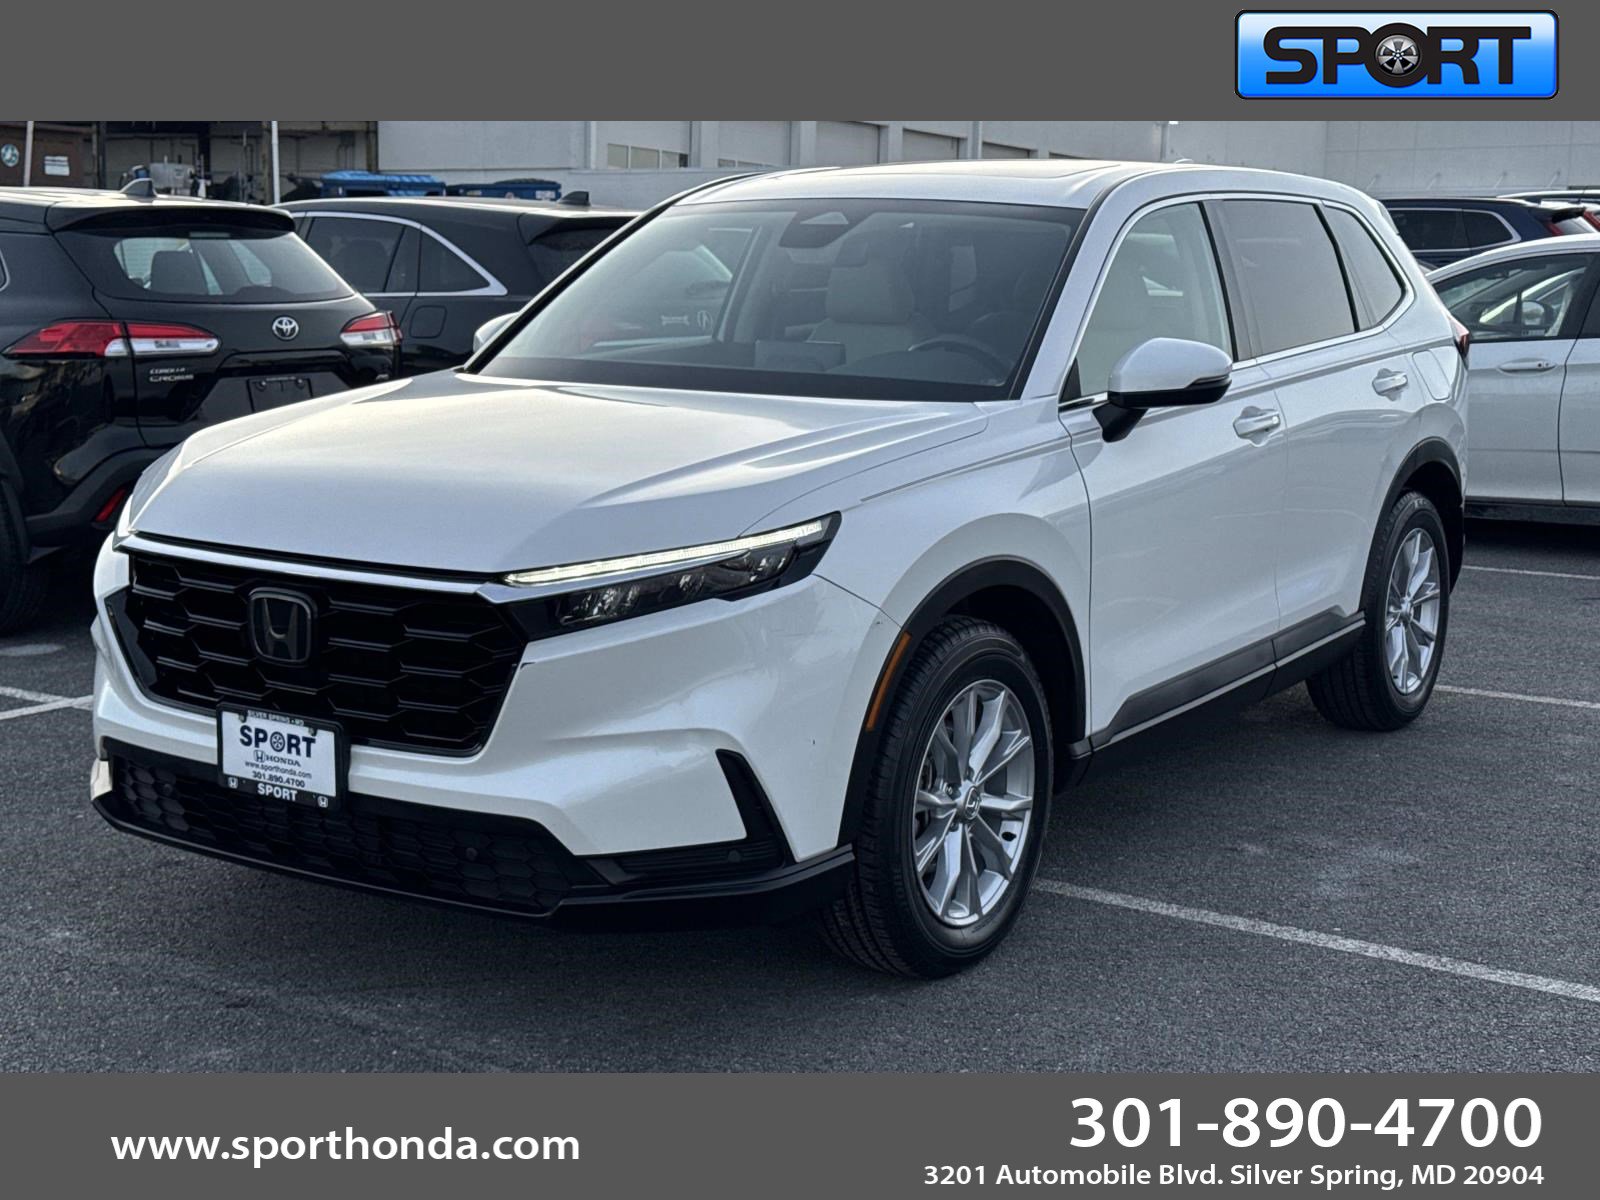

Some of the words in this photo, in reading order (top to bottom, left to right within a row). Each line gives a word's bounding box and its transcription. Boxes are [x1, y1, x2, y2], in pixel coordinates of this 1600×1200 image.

[239, 725, 316, 757] SPORT
[244, 760, 312, 779] www.sporthonda.com
[266, 754, 302, 767] HONDA
[252, 770, 306, 789] 301.890.4700
[257, 782, 298, 802] SPORT
